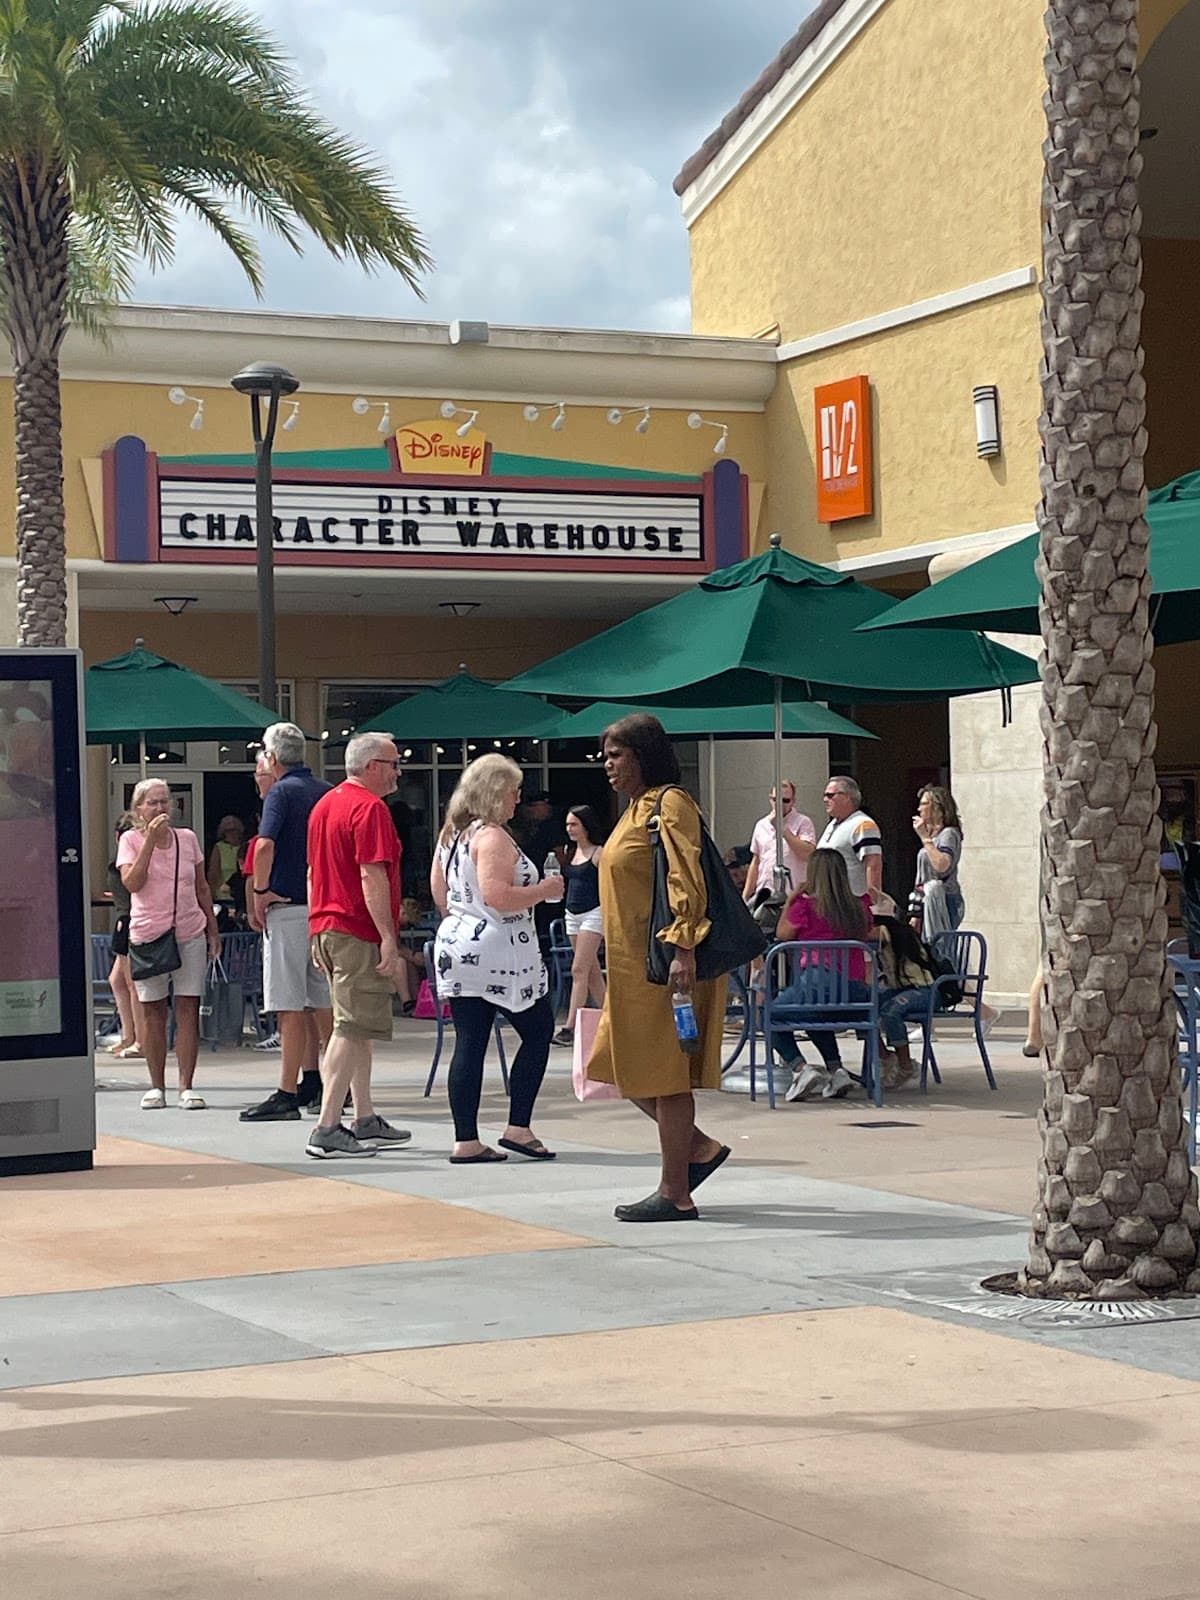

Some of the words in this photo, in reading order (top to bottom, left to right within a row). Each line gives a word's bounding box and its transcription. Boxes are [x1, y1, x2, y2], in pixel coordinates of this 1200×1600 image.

[399, 428, 482, 470] Disney
[377, 494, 502, 517] DISNEY
[456, 520, 684, 552] WAREHOUSE
